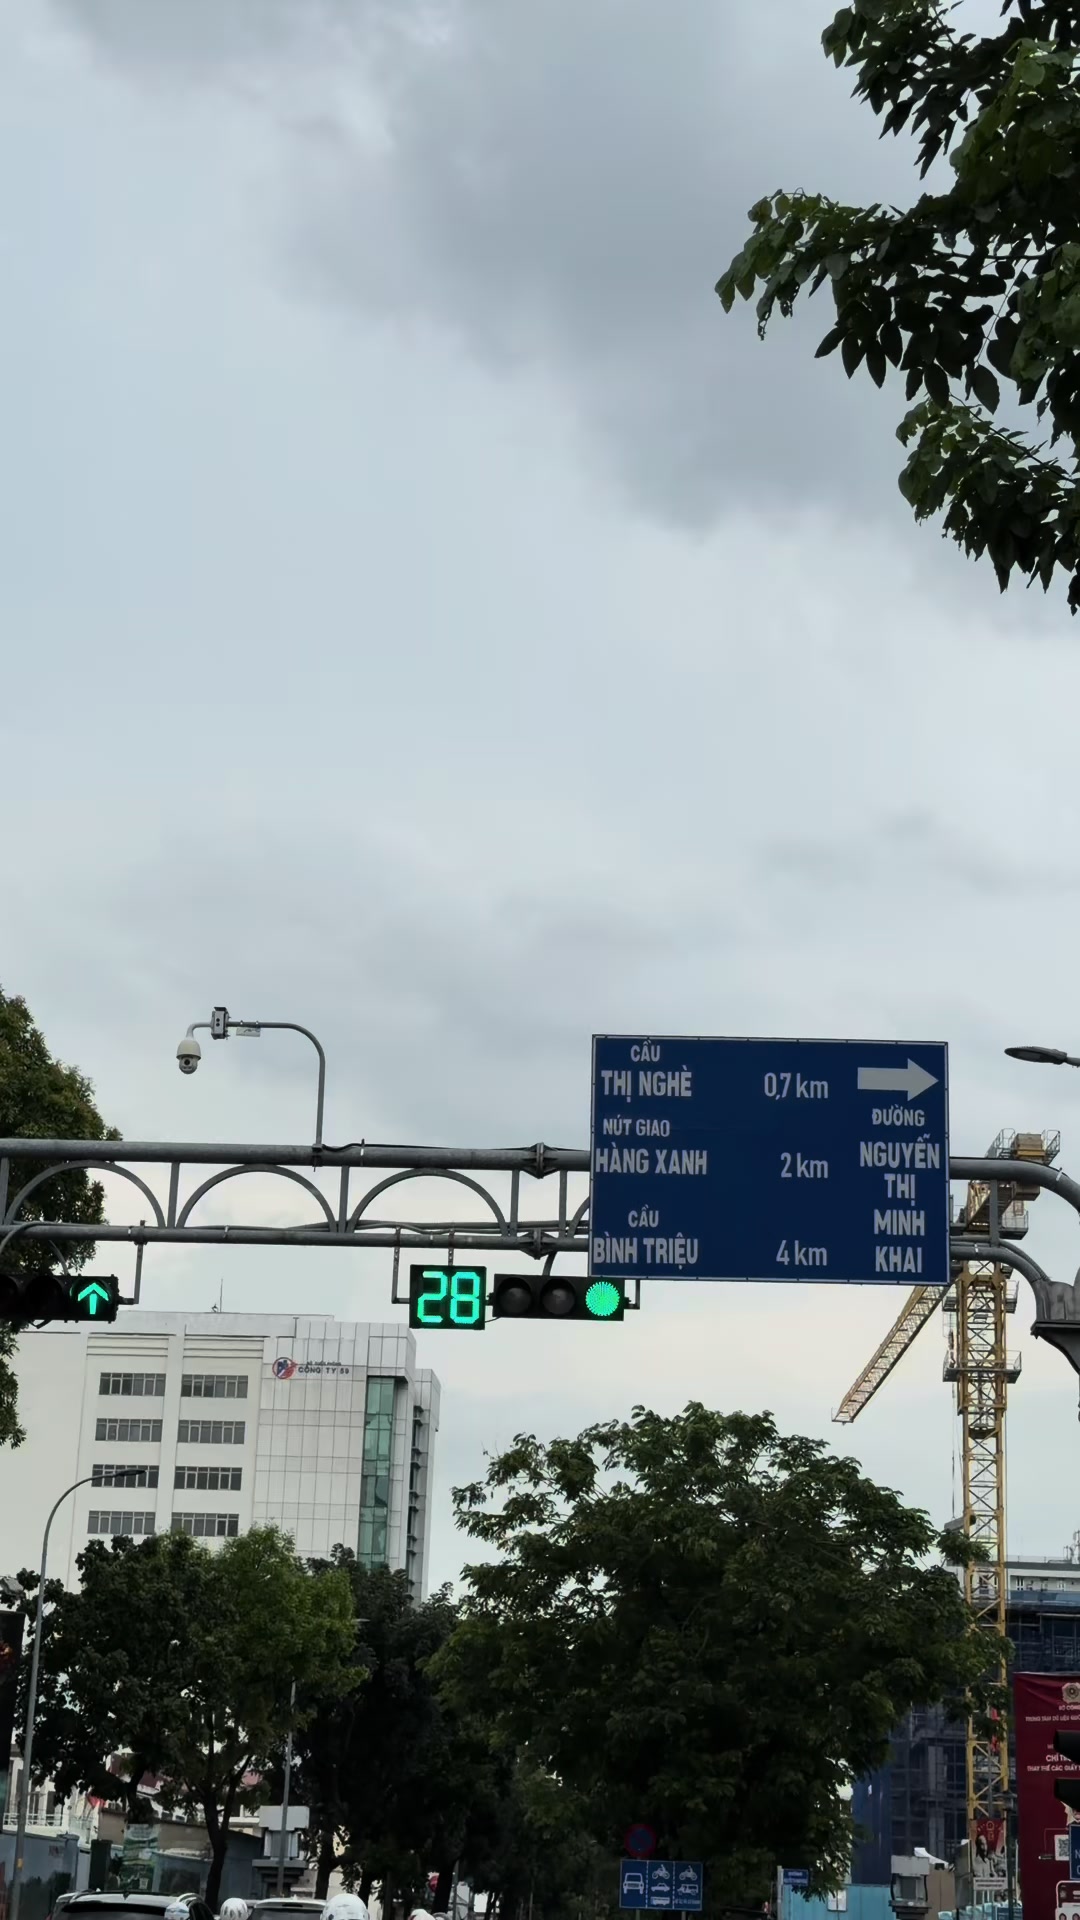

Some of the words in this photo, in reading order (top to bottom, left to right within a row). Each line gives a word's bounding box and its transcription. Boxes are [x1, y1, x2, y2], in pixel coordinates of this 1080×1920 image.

[630, 1040, 661, 1063] CẦU
[601, 1070, 632, 1103] THỊ
[638, 1065, 692, 1097] NGHÈ
[764, 1072, 792, 1100] 0,7
[796, 1073, 829, 1099] km
[603, 1115, 633, 1136] NÚT
[636, 1119, 671, 1138] GIAO
[872, 1105, 925, 1127] ĐƯỜNG
[595, 1142, 650, 1174] HÀNG
[654, 1149, 708, 1175] XANH
[859, 1133, 940, 1169] NGUYỄN
[780, 1152, 793, 1178] 2
[796, 1152, 829, 1179] km
[884, 1173, 916, 1206] THỊ
[627, 1205, 660, 1228] CẦU
[873, 1208, 925, 1236] MINH
[593, 1231, 638, 1264] BÌNH
[642, 1232, 699, 1270] TRIỆU
[776, 1240, 790, 1266] 4
[794, 1240, 828, 1266] km
[875, 1246, 922, 1273] KHAI
[417, 1271, 480, 1324] 28
